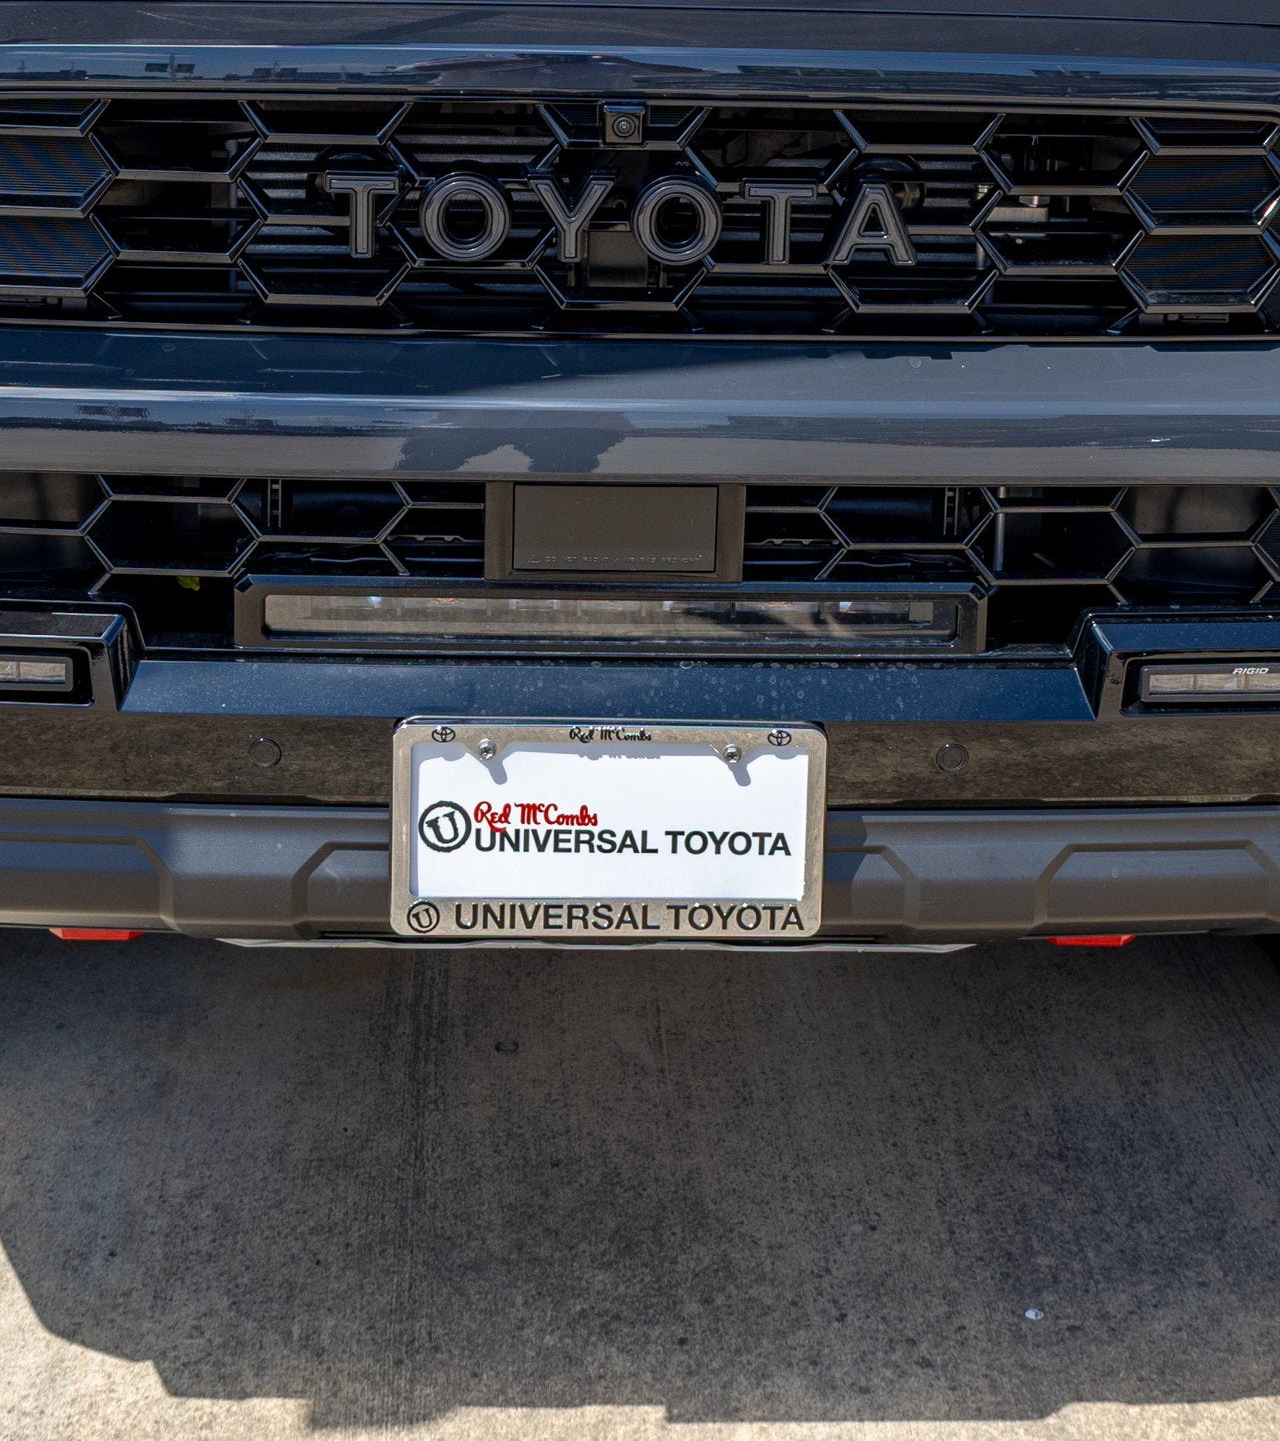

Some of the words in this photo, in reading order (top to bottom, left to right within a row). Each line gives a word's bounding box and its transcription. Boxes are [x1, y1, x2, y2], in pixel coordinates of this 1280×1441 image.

[324, 169, 917, 266] TOYOTA
[1232, 667, 1269, 675] RIGID
[569, 726, 594, 743] Red
[474, 801, 511, 833] Red
[514, 802, 598, 826] McCombs
[474, 828, 659, 854] UNIVERSAL
[665, 830, 792, 856] TOYOTA
[455, 903, 660, 930] UNIVERSAL
[666, 904, 805, 931] TOYOTA
